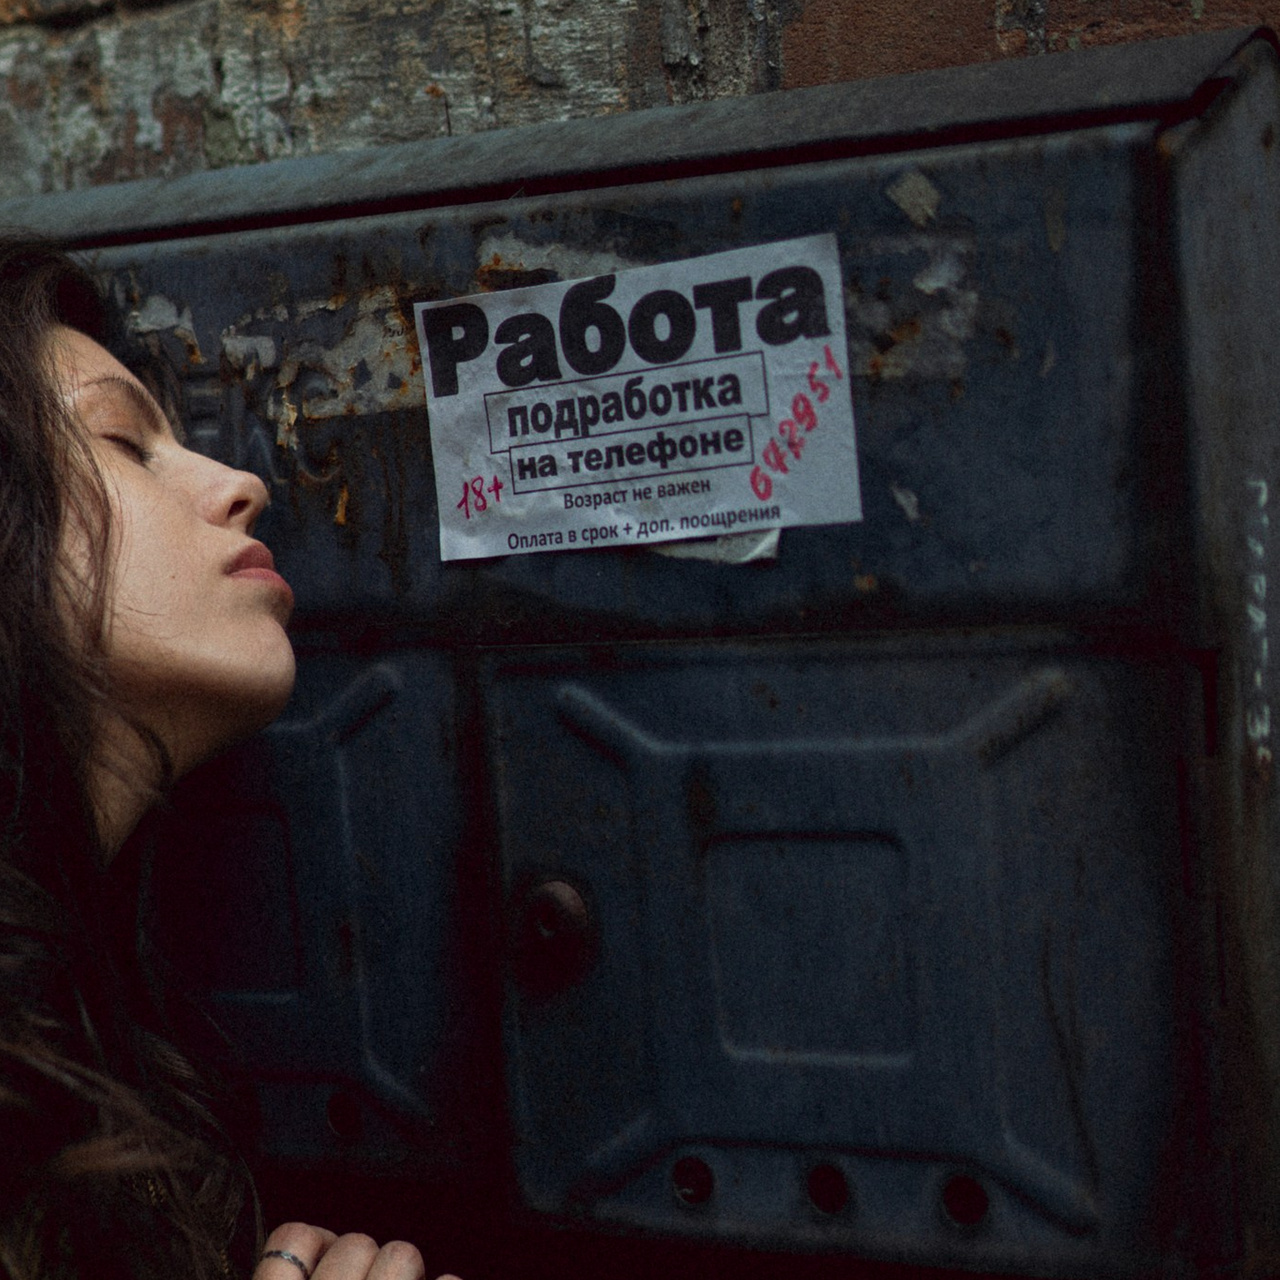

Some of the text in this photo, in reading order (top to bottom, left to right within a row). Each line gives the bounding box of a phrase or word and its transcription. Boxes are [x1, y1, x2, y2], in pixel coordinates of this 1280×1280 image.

[422, 266, 830, 397] Работа
[507, 373, 742, 438] подработка
[517, 429, 744, 480] на телефоне
[456, 475, 504, 519] 18+
[564, 479, 711, 510] Возраст не важен
[507, 531, 563, 549] Оплата
[568, 529, 577, 543] в
[581, 524, 618, 544] срок
[637, 517, 675, 538] доп.
[680, 505, 781, 529] поощрения
